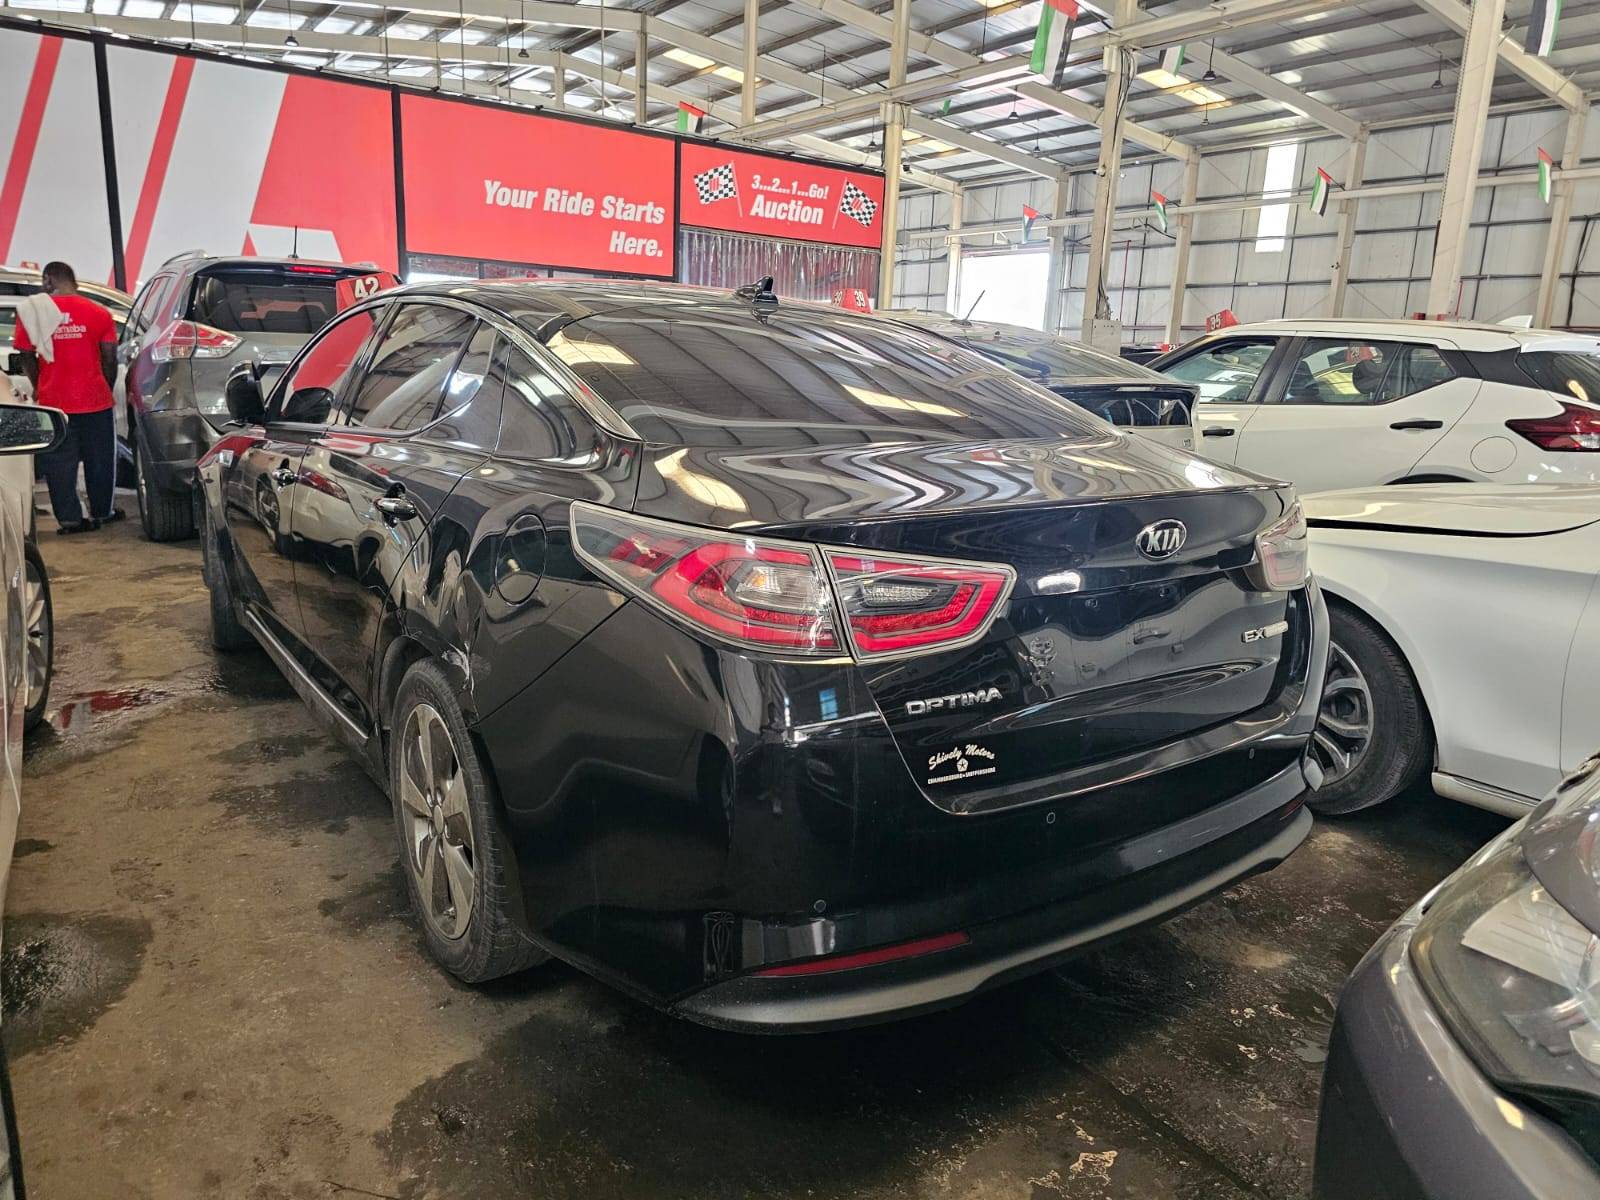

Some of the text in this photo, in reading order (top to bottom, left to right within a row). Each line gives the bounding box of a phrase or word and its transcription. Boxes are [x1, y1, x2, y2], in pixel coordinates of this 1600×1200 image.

[484, 179, 666, 225] Your Ride Starts
[749, 194, 824, 224] Auction
[609, 230, 663, 257] Here.
[354, 276, 379, 298] 42
[853, 289, 866, 307] 39
[1209, 313, 1222, 330] 35
[1146, 527, 1181, 553] KIA
[1243, 627, 1265, 643] EX
[904, 687, 1004, 715] OPTIMA
[965, 743, 996, 760] Motors
